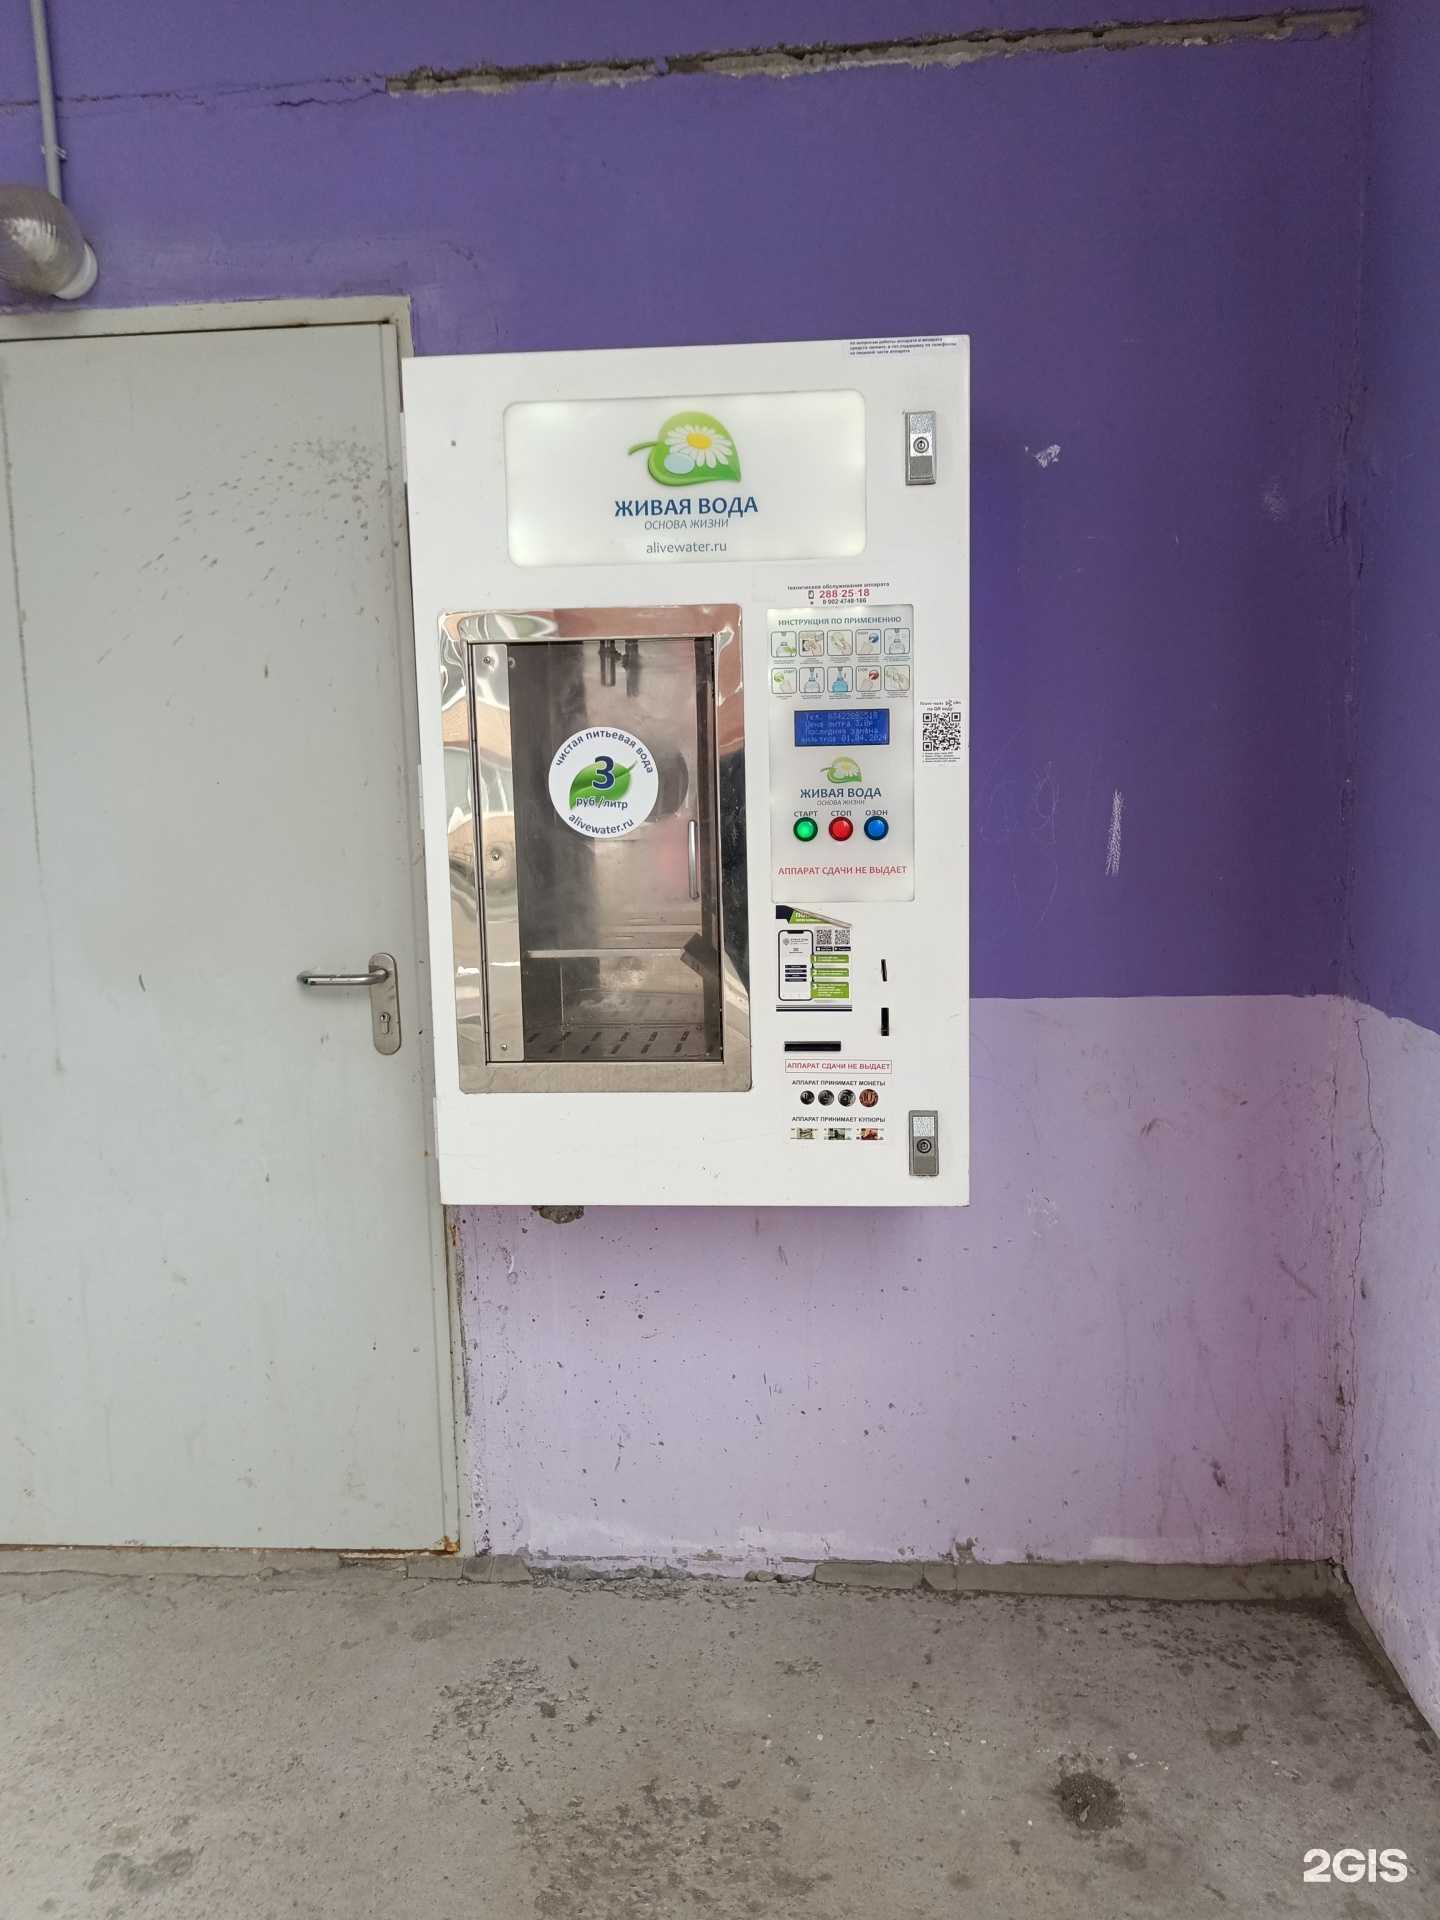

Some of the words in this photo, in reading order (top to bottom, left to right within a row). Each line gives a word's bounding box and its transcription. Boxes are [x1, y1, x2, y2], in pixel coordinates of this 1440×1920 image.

[615, 498, 691, 517] ЖИВАЯ
[699, 496, 758, 518] ВОДА
[644, 519, 688, 530] ОСНОВА
[690, 518, 729, 529] ЖИЗНИ
[646, 541, 727, 554] alivewater.ru
[819, 588, 871, 599] 288-25-18
[778, 618, 830, 627] ИНСТРУКЦИЯ
[844, 616, 902, 625] ПРИМЕНЕНИЮ
[556, 736, 584, 766] чистая
[586, 730, 637, 748] питьевая
[636, 748, 653, 773] вода
[592, 755, 615, 789] 3
[800, 788, 844, 799] ЖИВАЯ
[847, 787, 882, 799] ВОДА
[793, 810, 818, 818] СТАРТ
[568, 814, 634, 835] alivewater.ru
[778, 867, 819, 876] АППАРАТ
[822, 867, 853, 876] СДАЧИ
[869, 866, 907, 876] ВЫДАЕТ
[787, 1062, 820, 1070] АППАРАТ
[821, 1062, 846, 1071] СДАЧИ
[859, 1063, 890, 1071] ВЫДАЕТ
[858, 1116, 886, 1124] КУПЮРЫ
